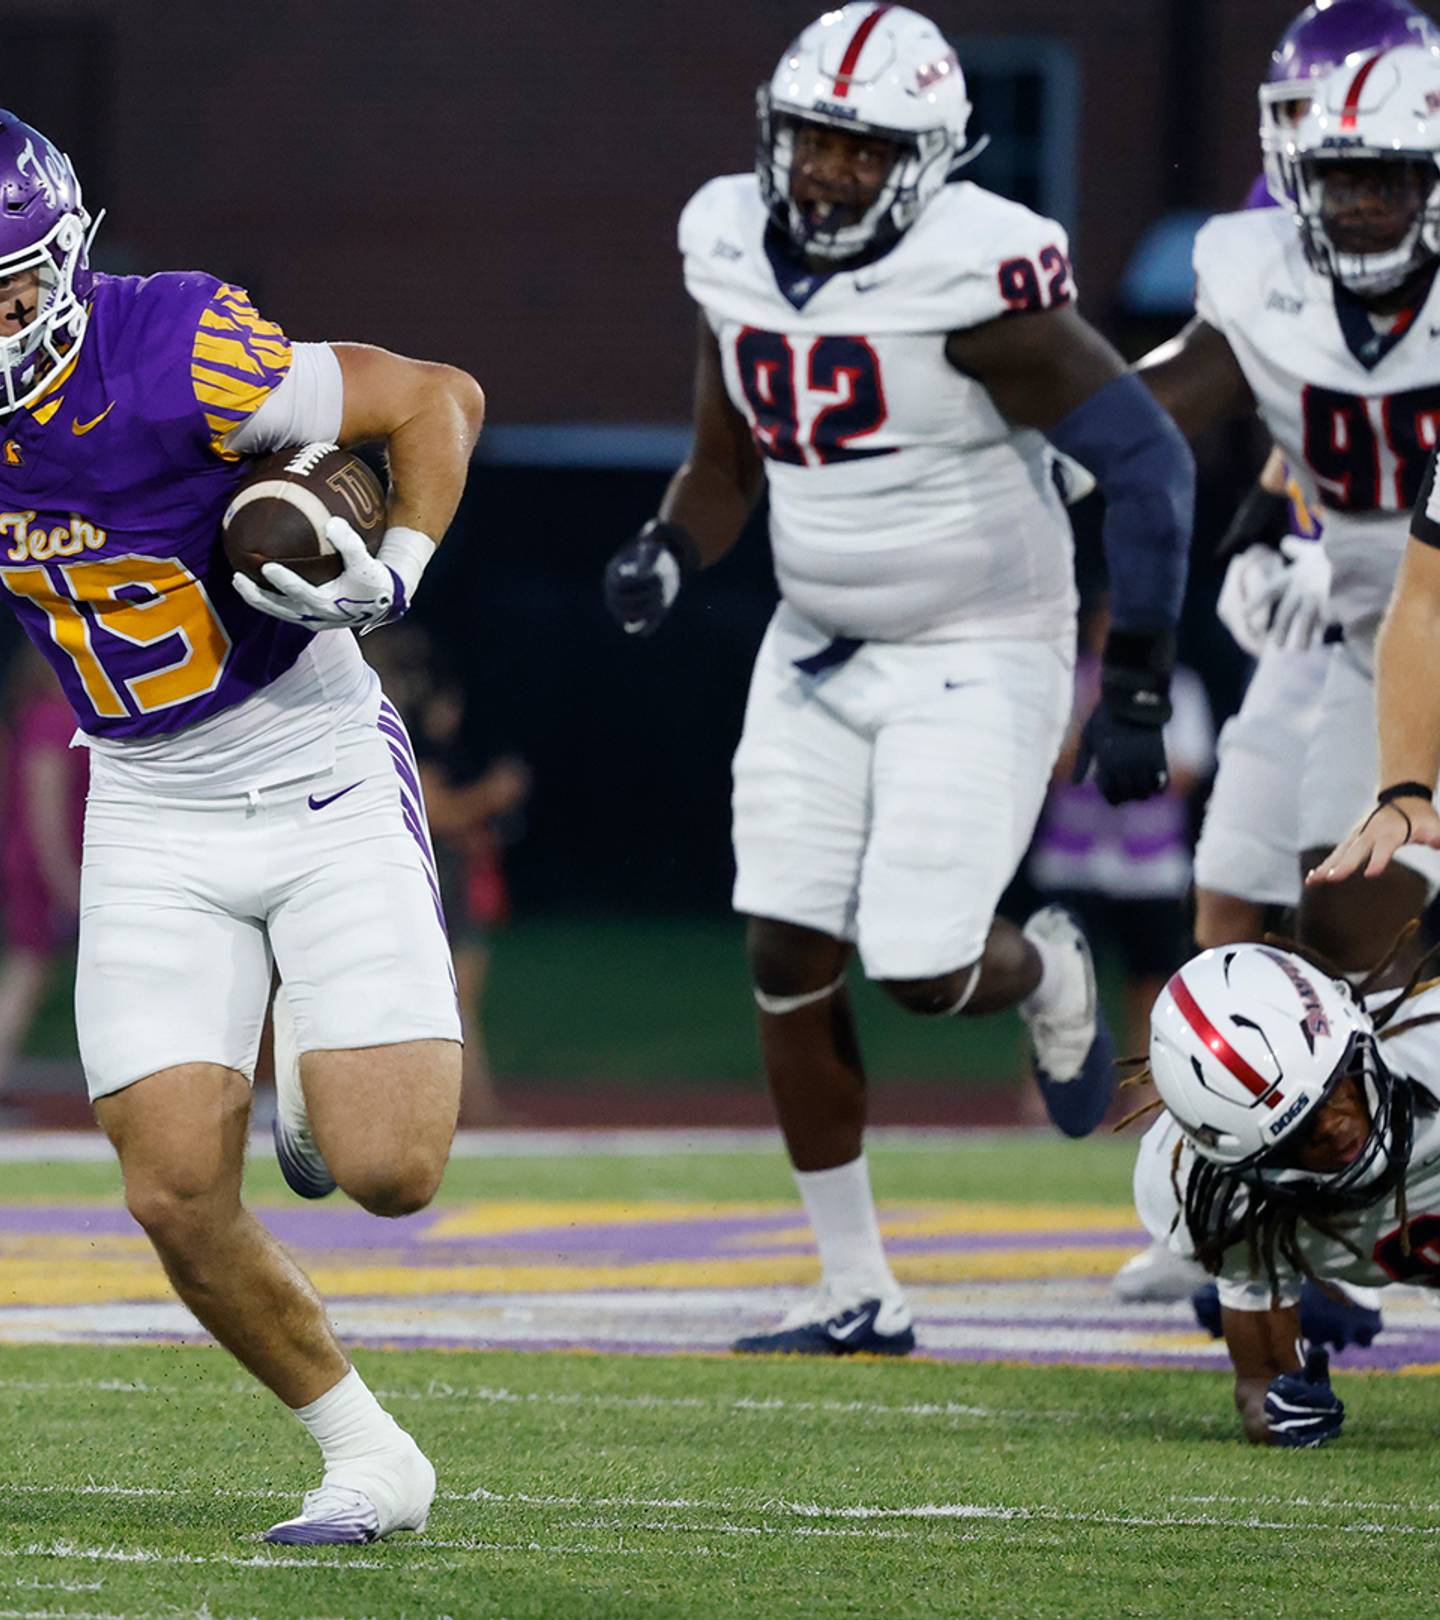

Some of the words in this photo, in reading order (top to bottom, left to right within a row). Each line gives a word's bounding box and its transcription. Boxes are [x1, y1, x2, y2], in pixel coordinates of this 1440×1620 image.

[997, 244, 1071, 310] 92
[735, 324, 902, 468] 92
[1270, 1092, 1310, 1136] DOGS
